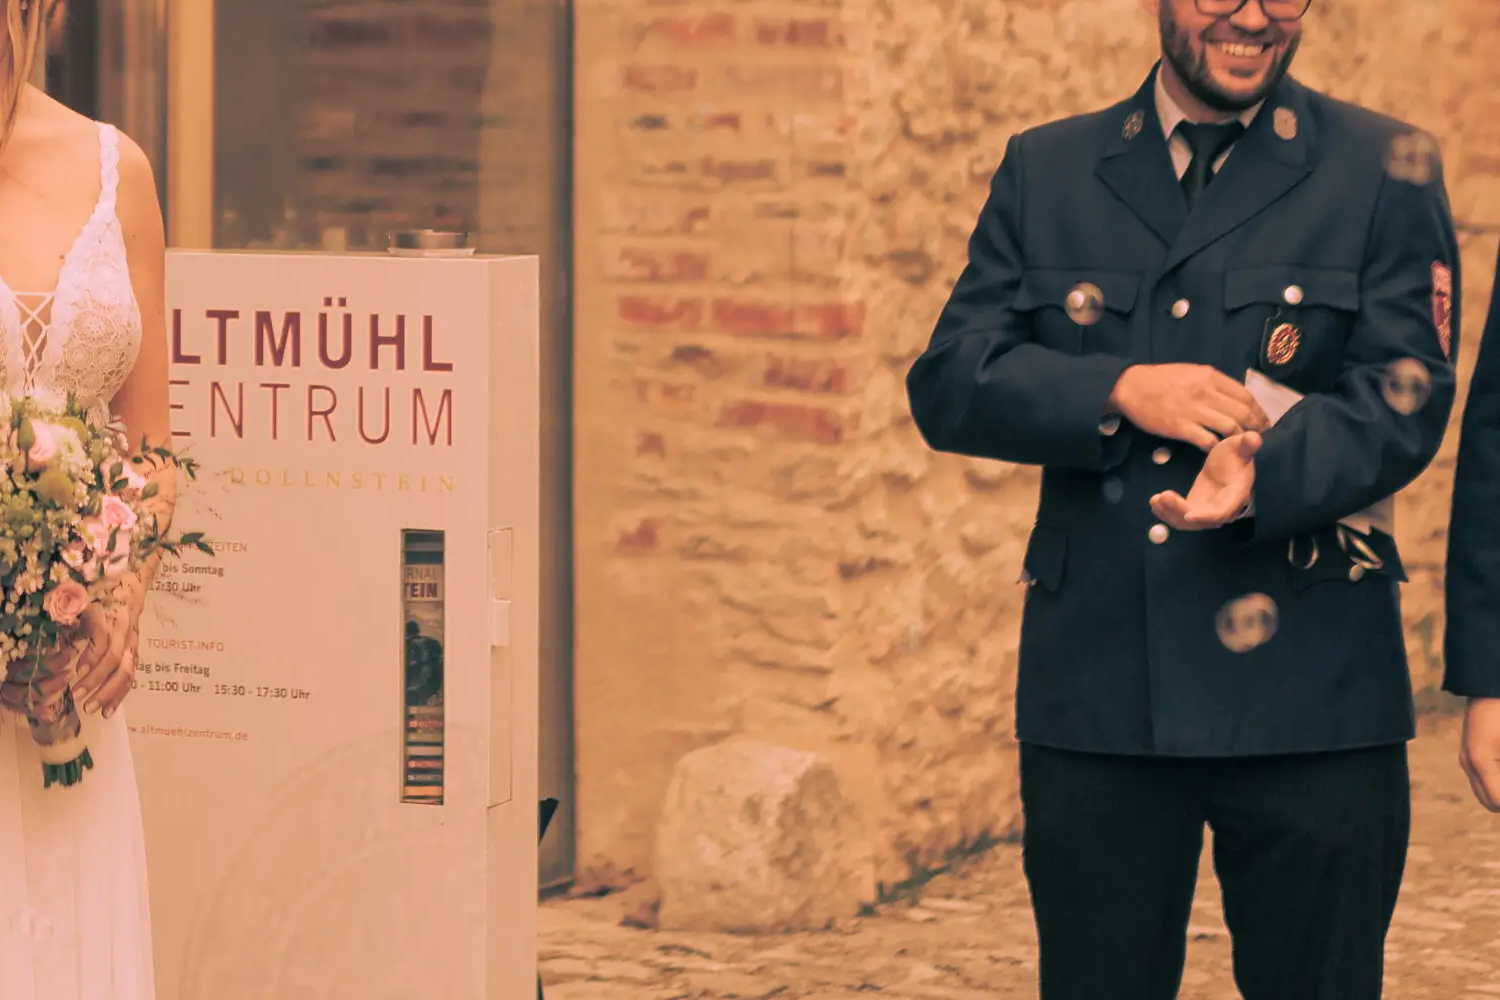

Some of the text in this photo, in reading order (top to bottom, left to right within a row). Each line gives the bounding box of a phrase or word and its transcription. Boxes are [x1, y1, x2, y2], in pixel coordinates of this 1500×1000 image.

[172, 297, 453, 372] LTMÜHL
[169, 380, 453, 446] ENTRUM
[229, 467, 455, 492] DOLLNSTEIN
[182, 563, 225, 577] Sonntag
[405, 567, 438, 580] RNAL
[182, 582, 201, 592] Uhr
[147, 638, 224, 652] TOURIST-INFO
[155, 662, 171, 673] bis
[174, 663, 210, 678] Freitag
[149, 681, 179, 692] 11:00
[182, 682, 202, 693] Uhr
[214, 684, 246, 697] 15:30
[257, 686, 288, 699] 17:30
[290, 688, 311, 700] Uhr
[127, 725, 248, 741] w.altmuehlzentrum.de
